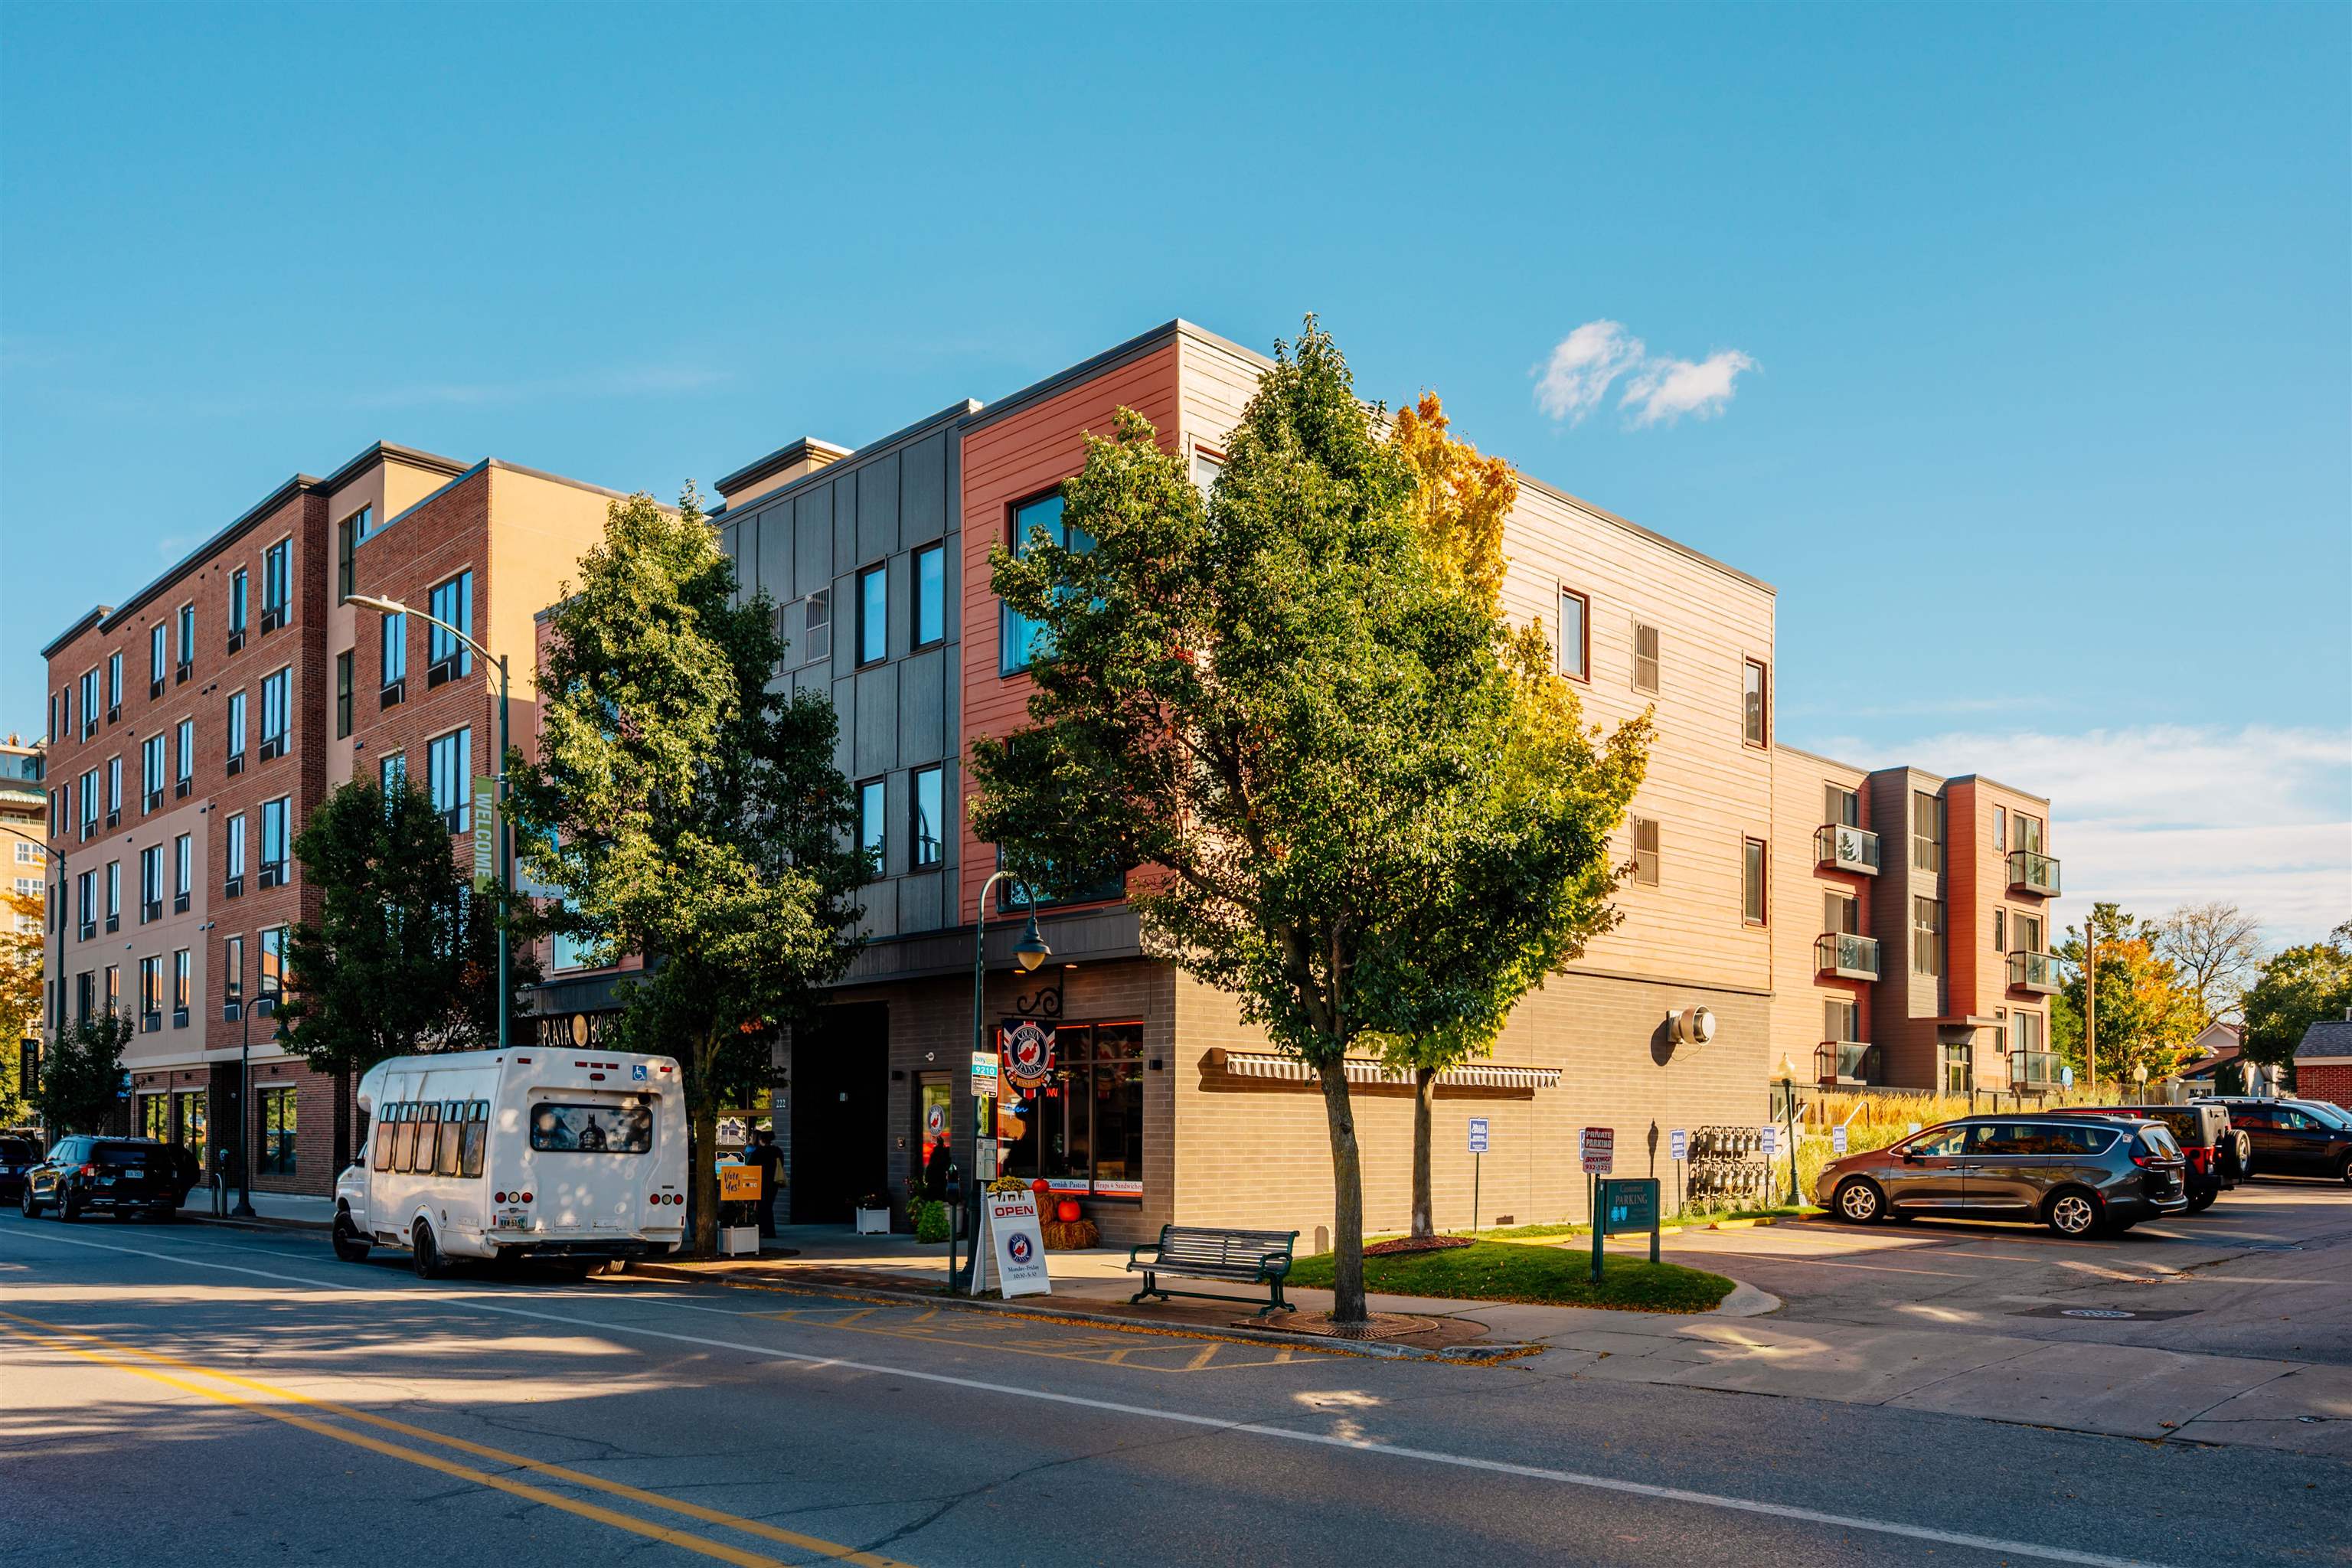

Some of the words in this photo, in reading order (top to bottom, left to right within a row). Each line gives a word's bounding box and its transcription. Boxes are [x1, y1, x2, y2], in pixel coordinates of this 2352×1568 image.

[475, 793, 492, 878] WELCOME
[542, 1018, 571, 1047] PLAYA
[1016, 1028, 1041, 1041] COUSIN
[975, 1066, 995, 1075] 9210
[776, 1099, 786, 1108] 222
[1586, 1138, 1612, 1148] PARKING
[724, 1171, 740, 1183] Vote
[725, 1180, 740, 1194] Yes!
[1095, 1181, 1110, 1190] Wraps
[1615, 1194, 1648, 1205] PARKING
[995, 1205, 1034, 1217] OPEN
